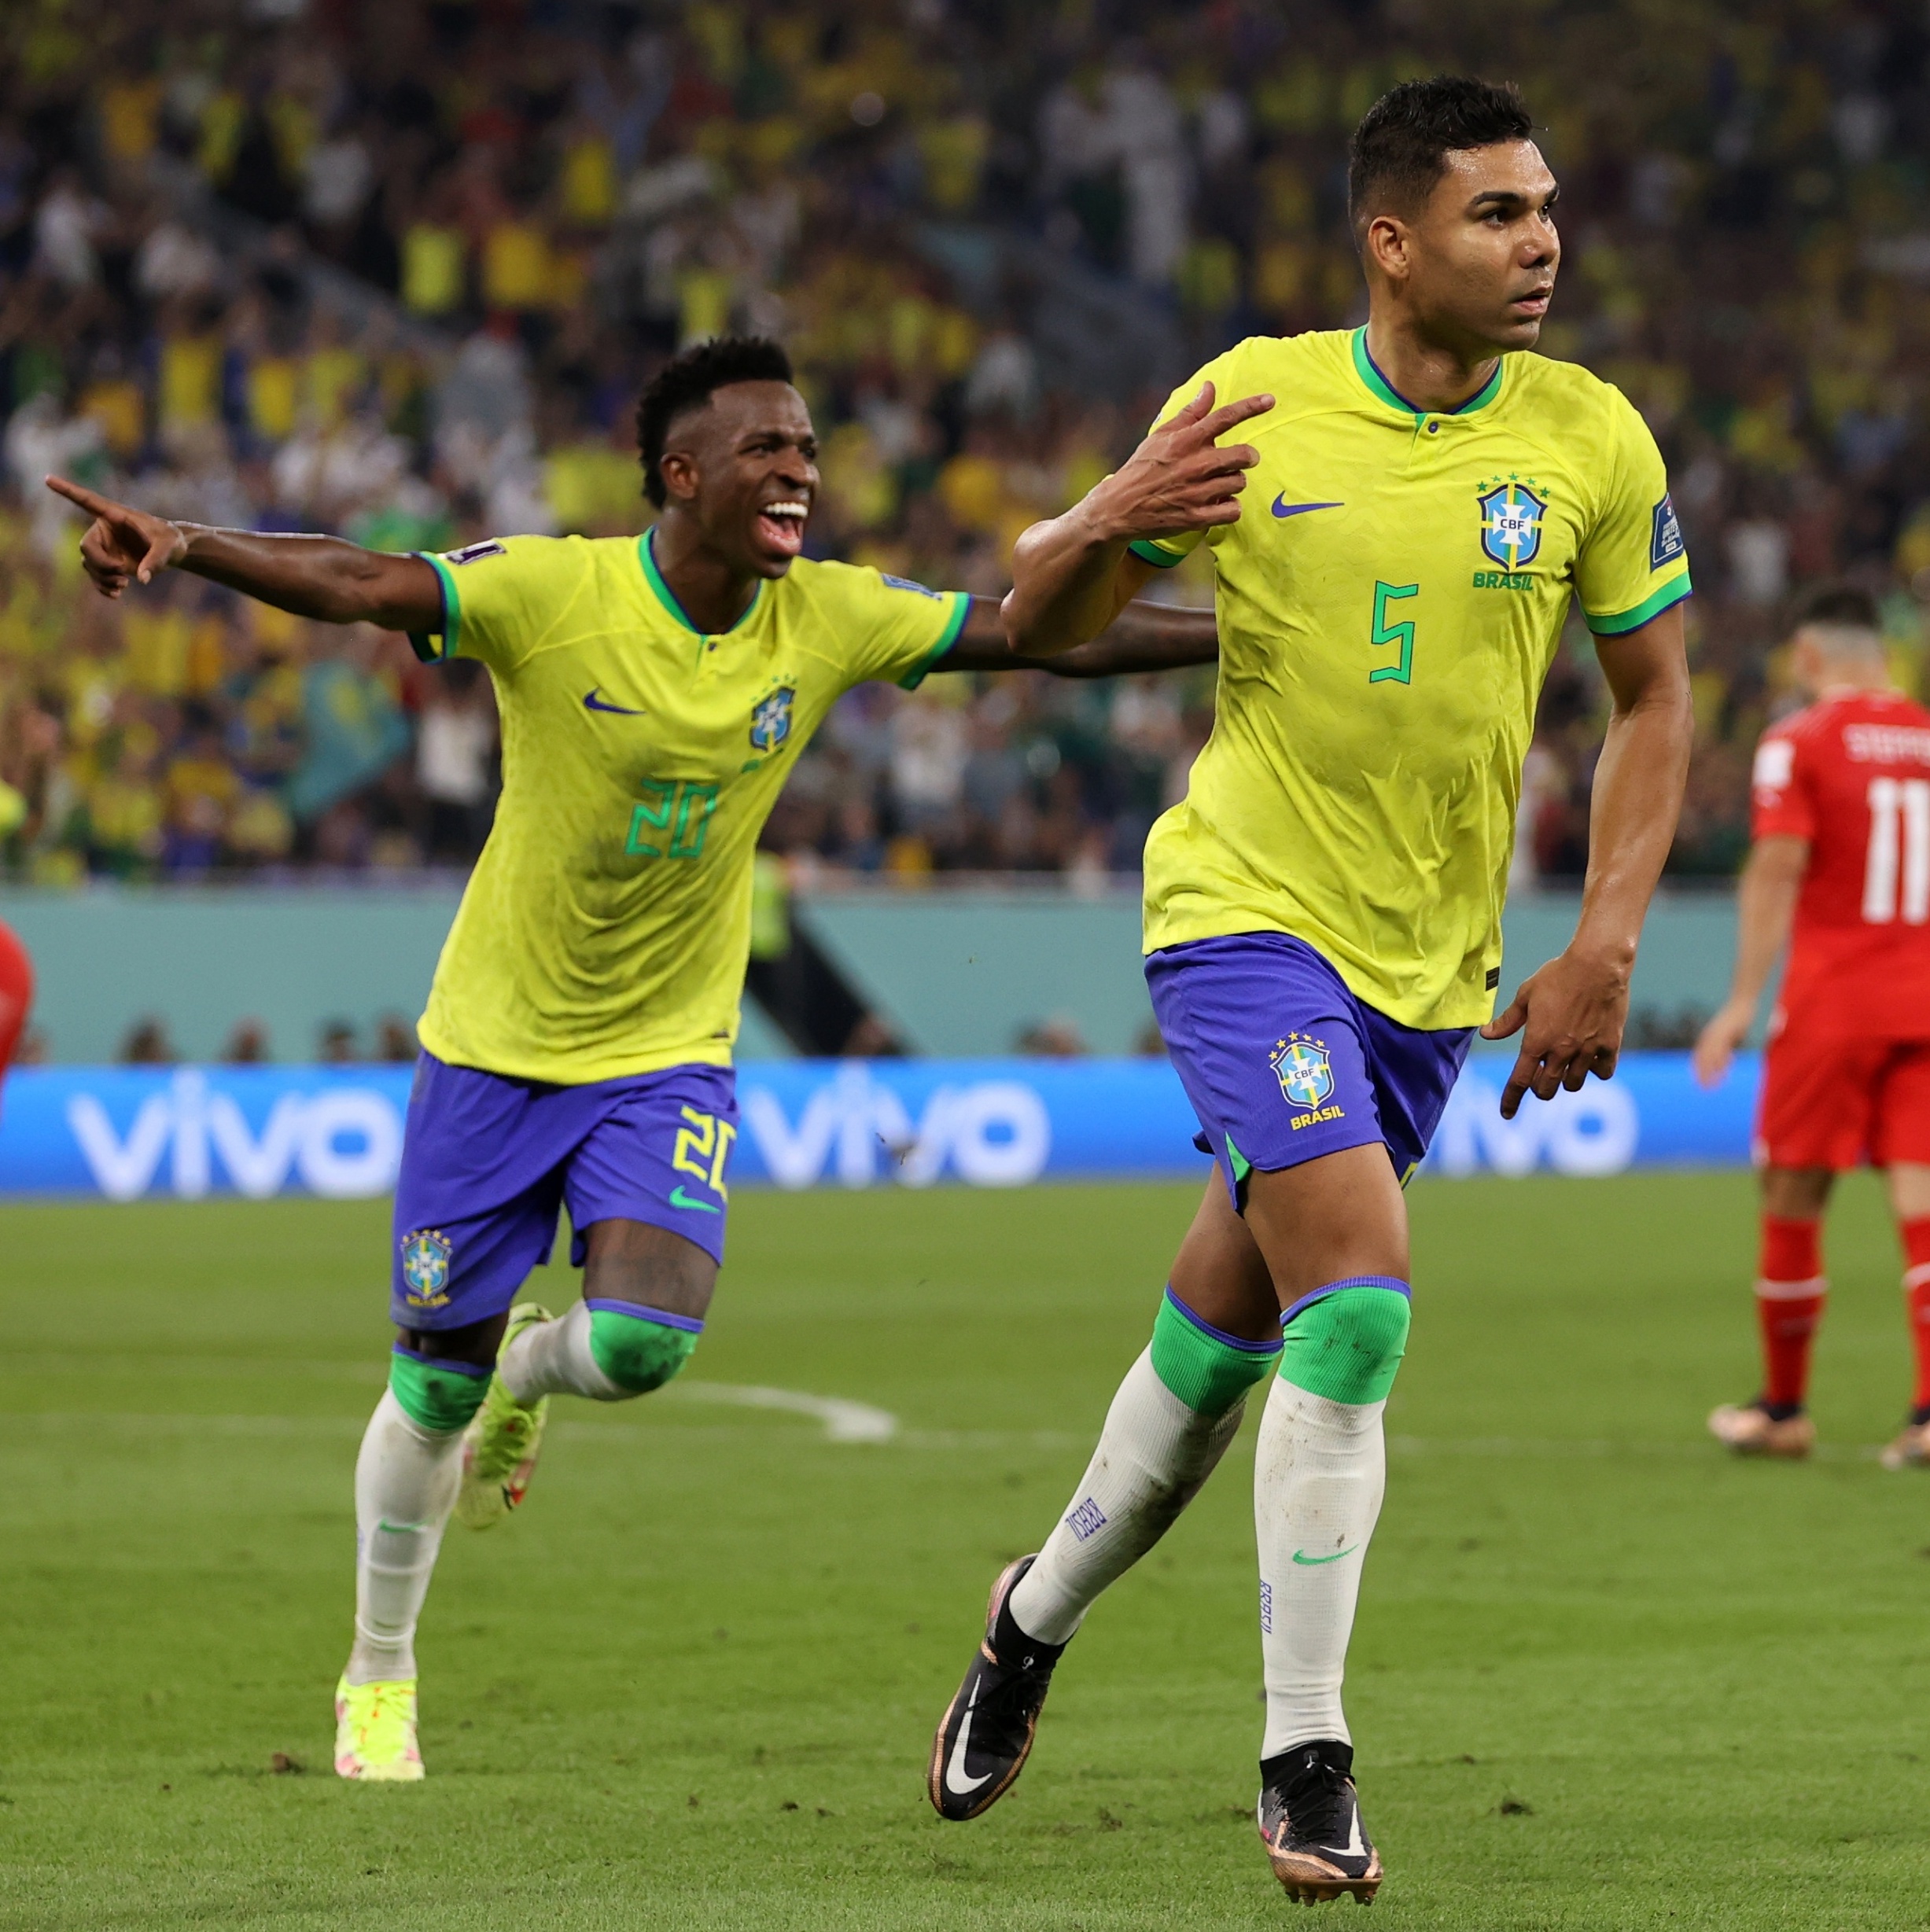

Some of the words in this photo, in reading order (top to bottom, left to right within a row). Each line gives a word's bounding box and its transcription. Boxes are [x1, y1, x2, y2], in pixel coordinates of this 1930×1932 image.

[1500, 517, 1525, 530] CBF
[1472, 571, 1534, 591] BRASIL
[1369, 579, 1420, 686] 5
[624, 778, 722, 859] 20
[1861, 775, 1930, 926] 11
[1294, 1067, 1316, 1080] CBF
[68, 1066, 403, 1200] vivo
[743, 1059, 1052, 1189] vivo
[1290, 1105, 1346, 1131] BRASIL
[1065, 1496, 1107, 1542] BRASIL
